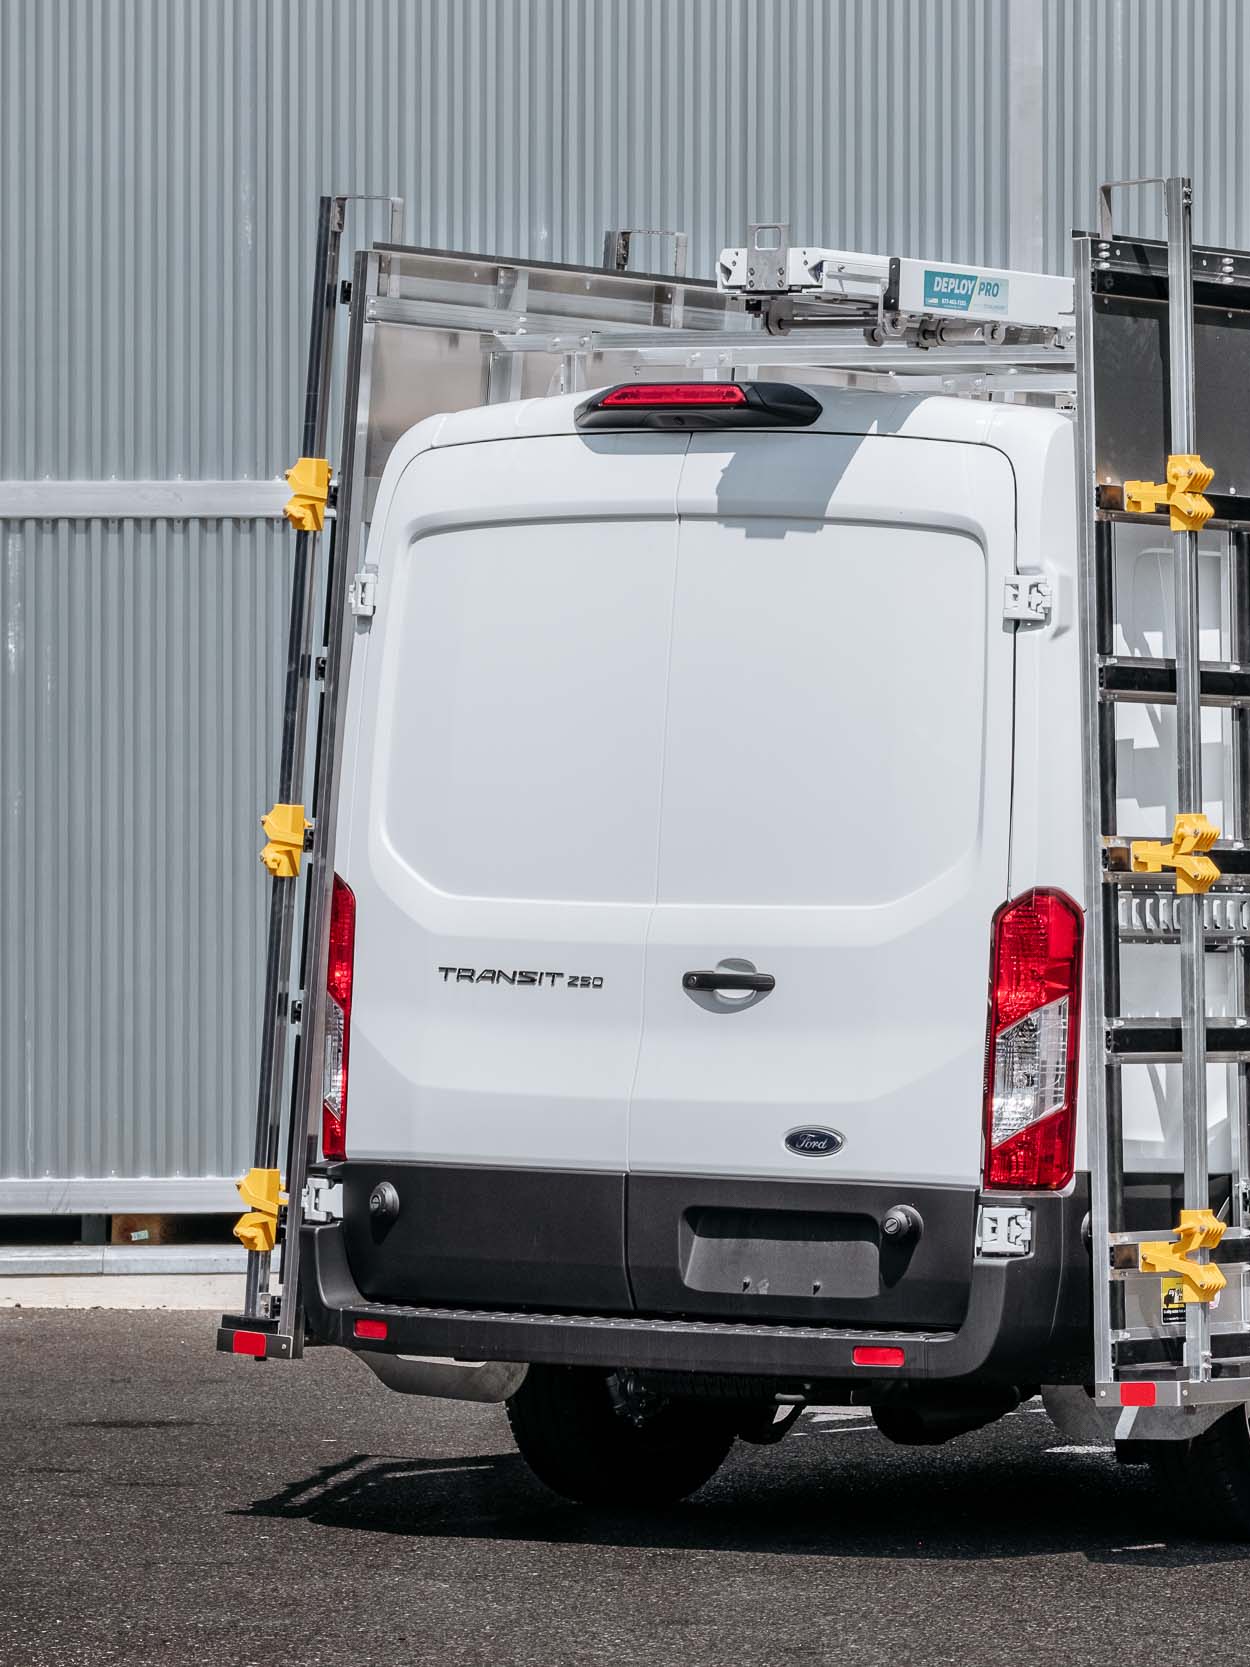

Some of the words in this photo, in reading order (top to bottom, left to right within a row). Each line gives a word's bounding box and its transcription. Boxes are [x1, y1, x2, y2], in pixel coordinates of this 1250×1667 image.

[933, 276, 976, 295] DEPLOY
[978, 281, 1000, 298] PRO
[438, 966, 564, 987] TRANSIT
[567, 975, 604, 989] 250
[795, 1133, 829, 1149] Ford
